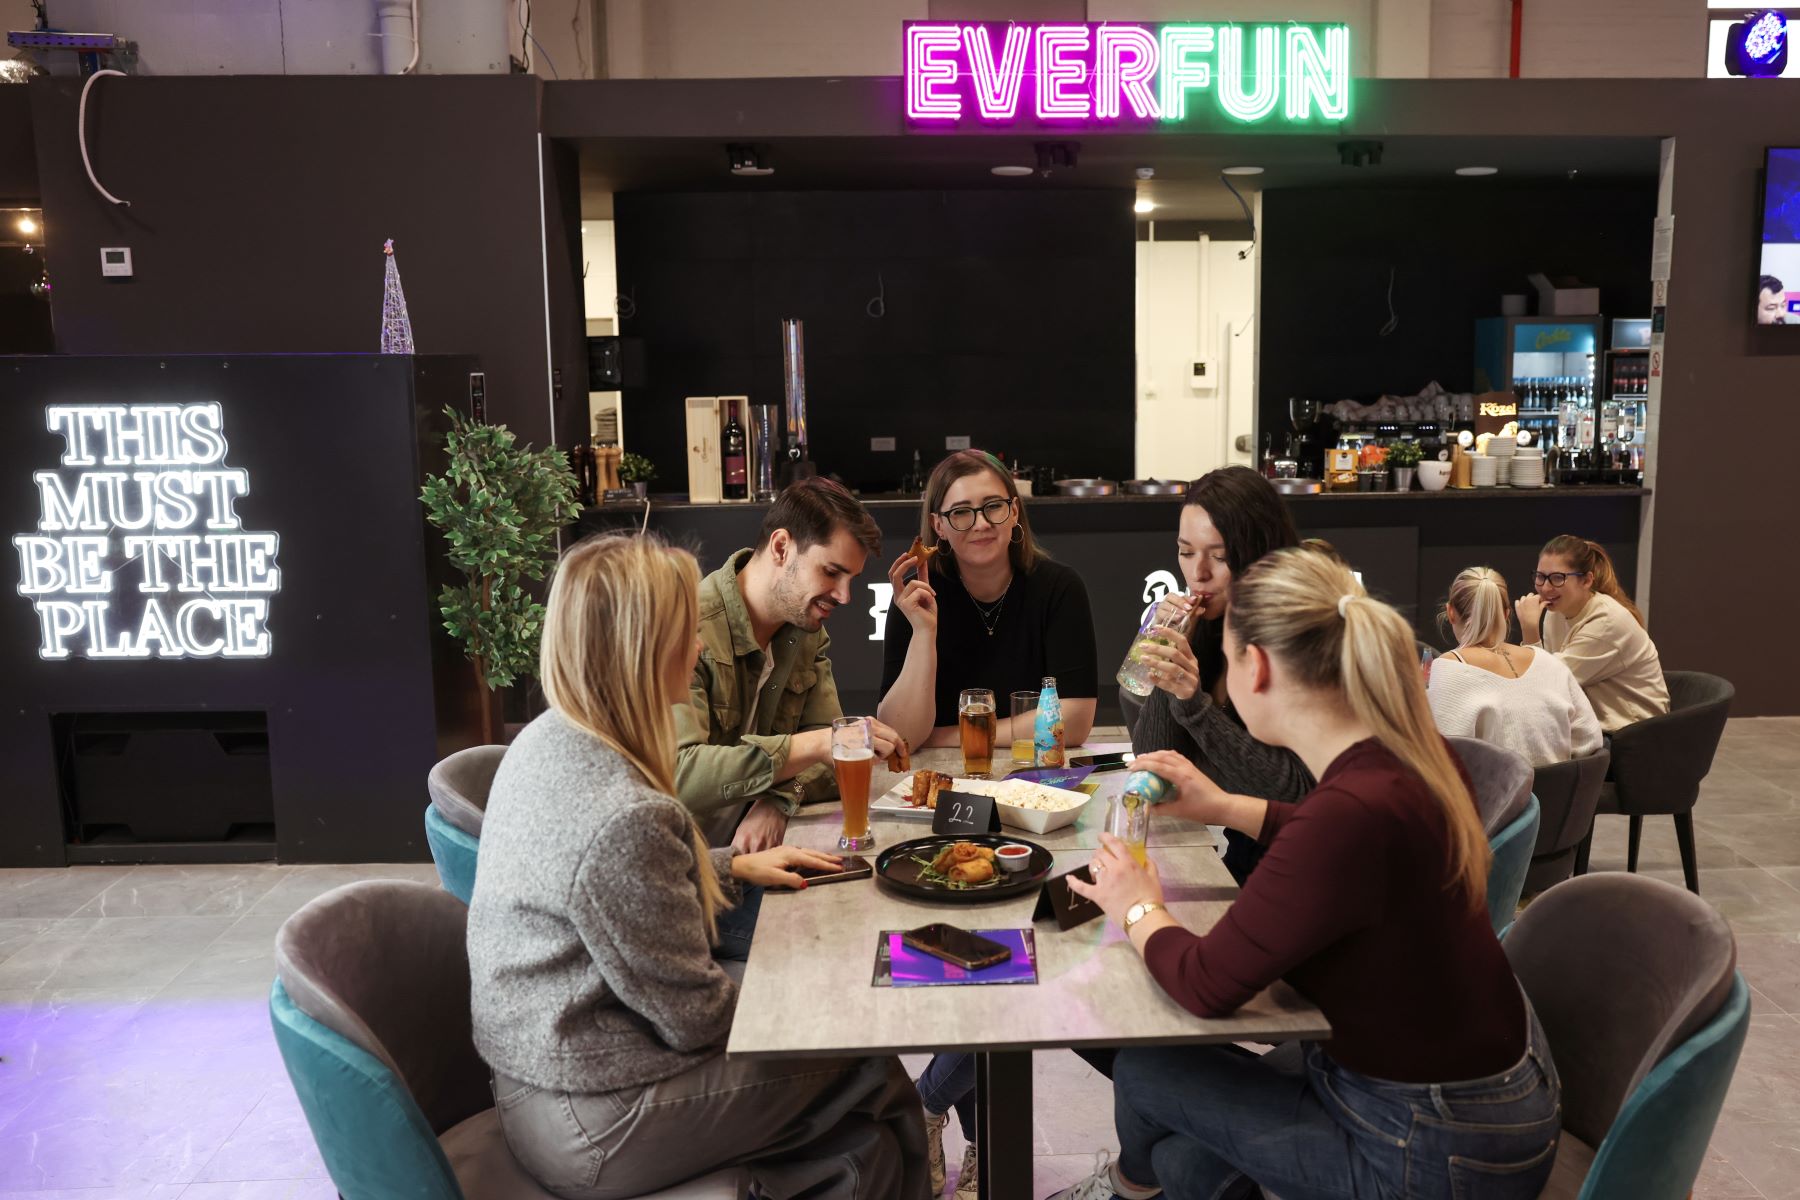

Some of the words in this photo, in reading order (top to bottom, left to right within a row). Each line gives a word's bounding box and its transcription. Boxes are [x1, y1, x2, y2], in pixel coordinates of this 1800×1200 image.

[907, 26, 1349, 119] EVERFUN
[48, 404, 224, 466] THIS
[1479, 402, 1516, 416] Kozel
[36, 470, 247, 530] MUST
[14, 536, 112, 593] BE
[123, 534, 278, 592] THE
[36, 598, 269, 658] PLACE
[948, 802, 974, 825] 22
